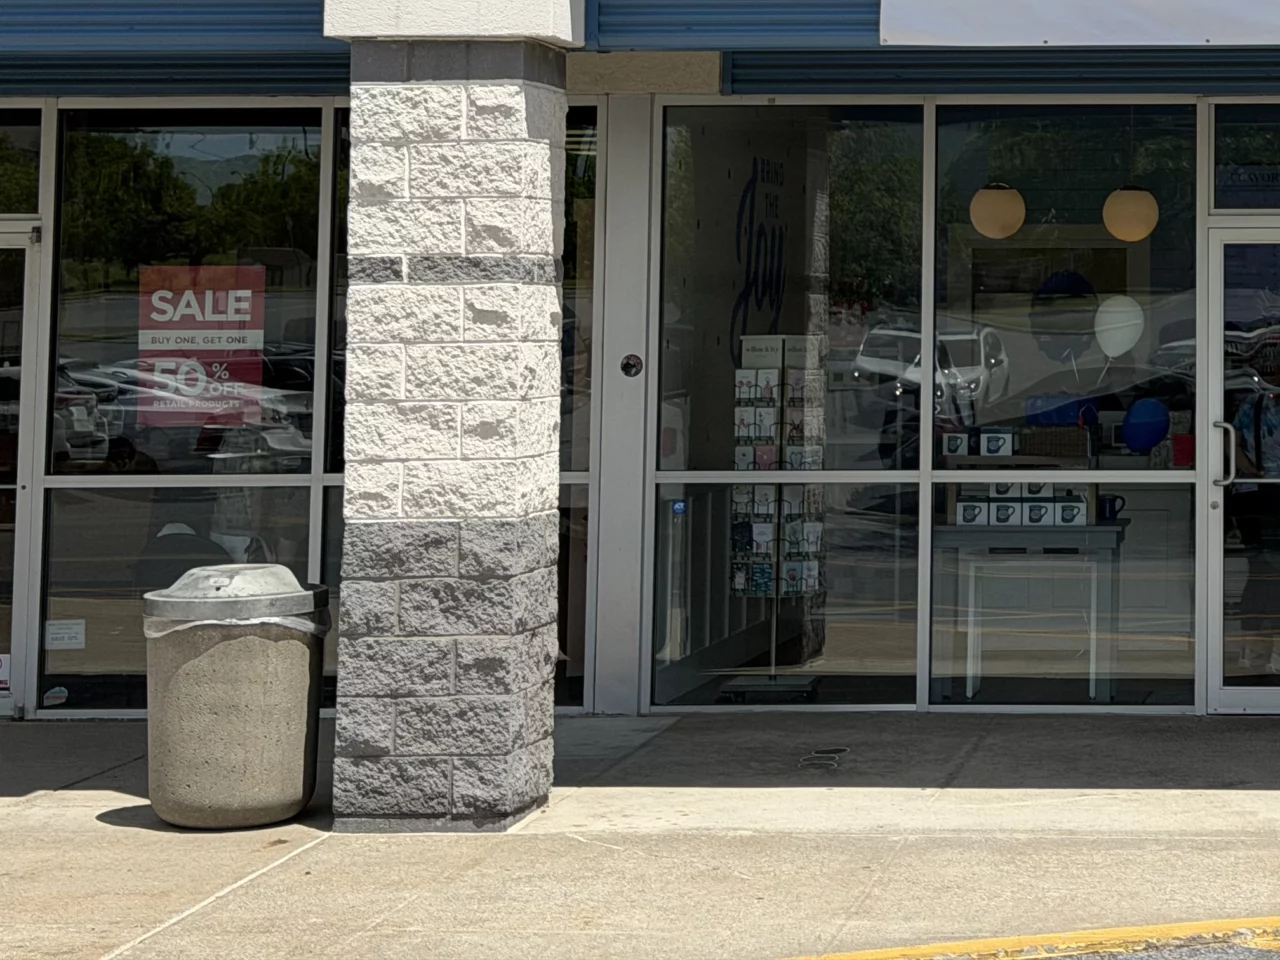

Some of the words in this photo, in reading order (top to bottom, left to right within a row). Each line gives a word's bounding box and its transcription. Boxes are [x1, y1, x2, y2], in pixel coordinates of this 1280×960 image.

[764, 192, 779, 219] THE
[150, 289, 252, 322] SALE
[151, 336, 171, 344] BUY
[174, 336, 200, 346] ONE,
[202, 336, 223, 344] GET
[226, 336, 248, 344] ONE
[209, 382, 245, 397] OFF
[153, 400, 186, 408] RETAIL
[189, 400, 240, 408] PRODUCTS
